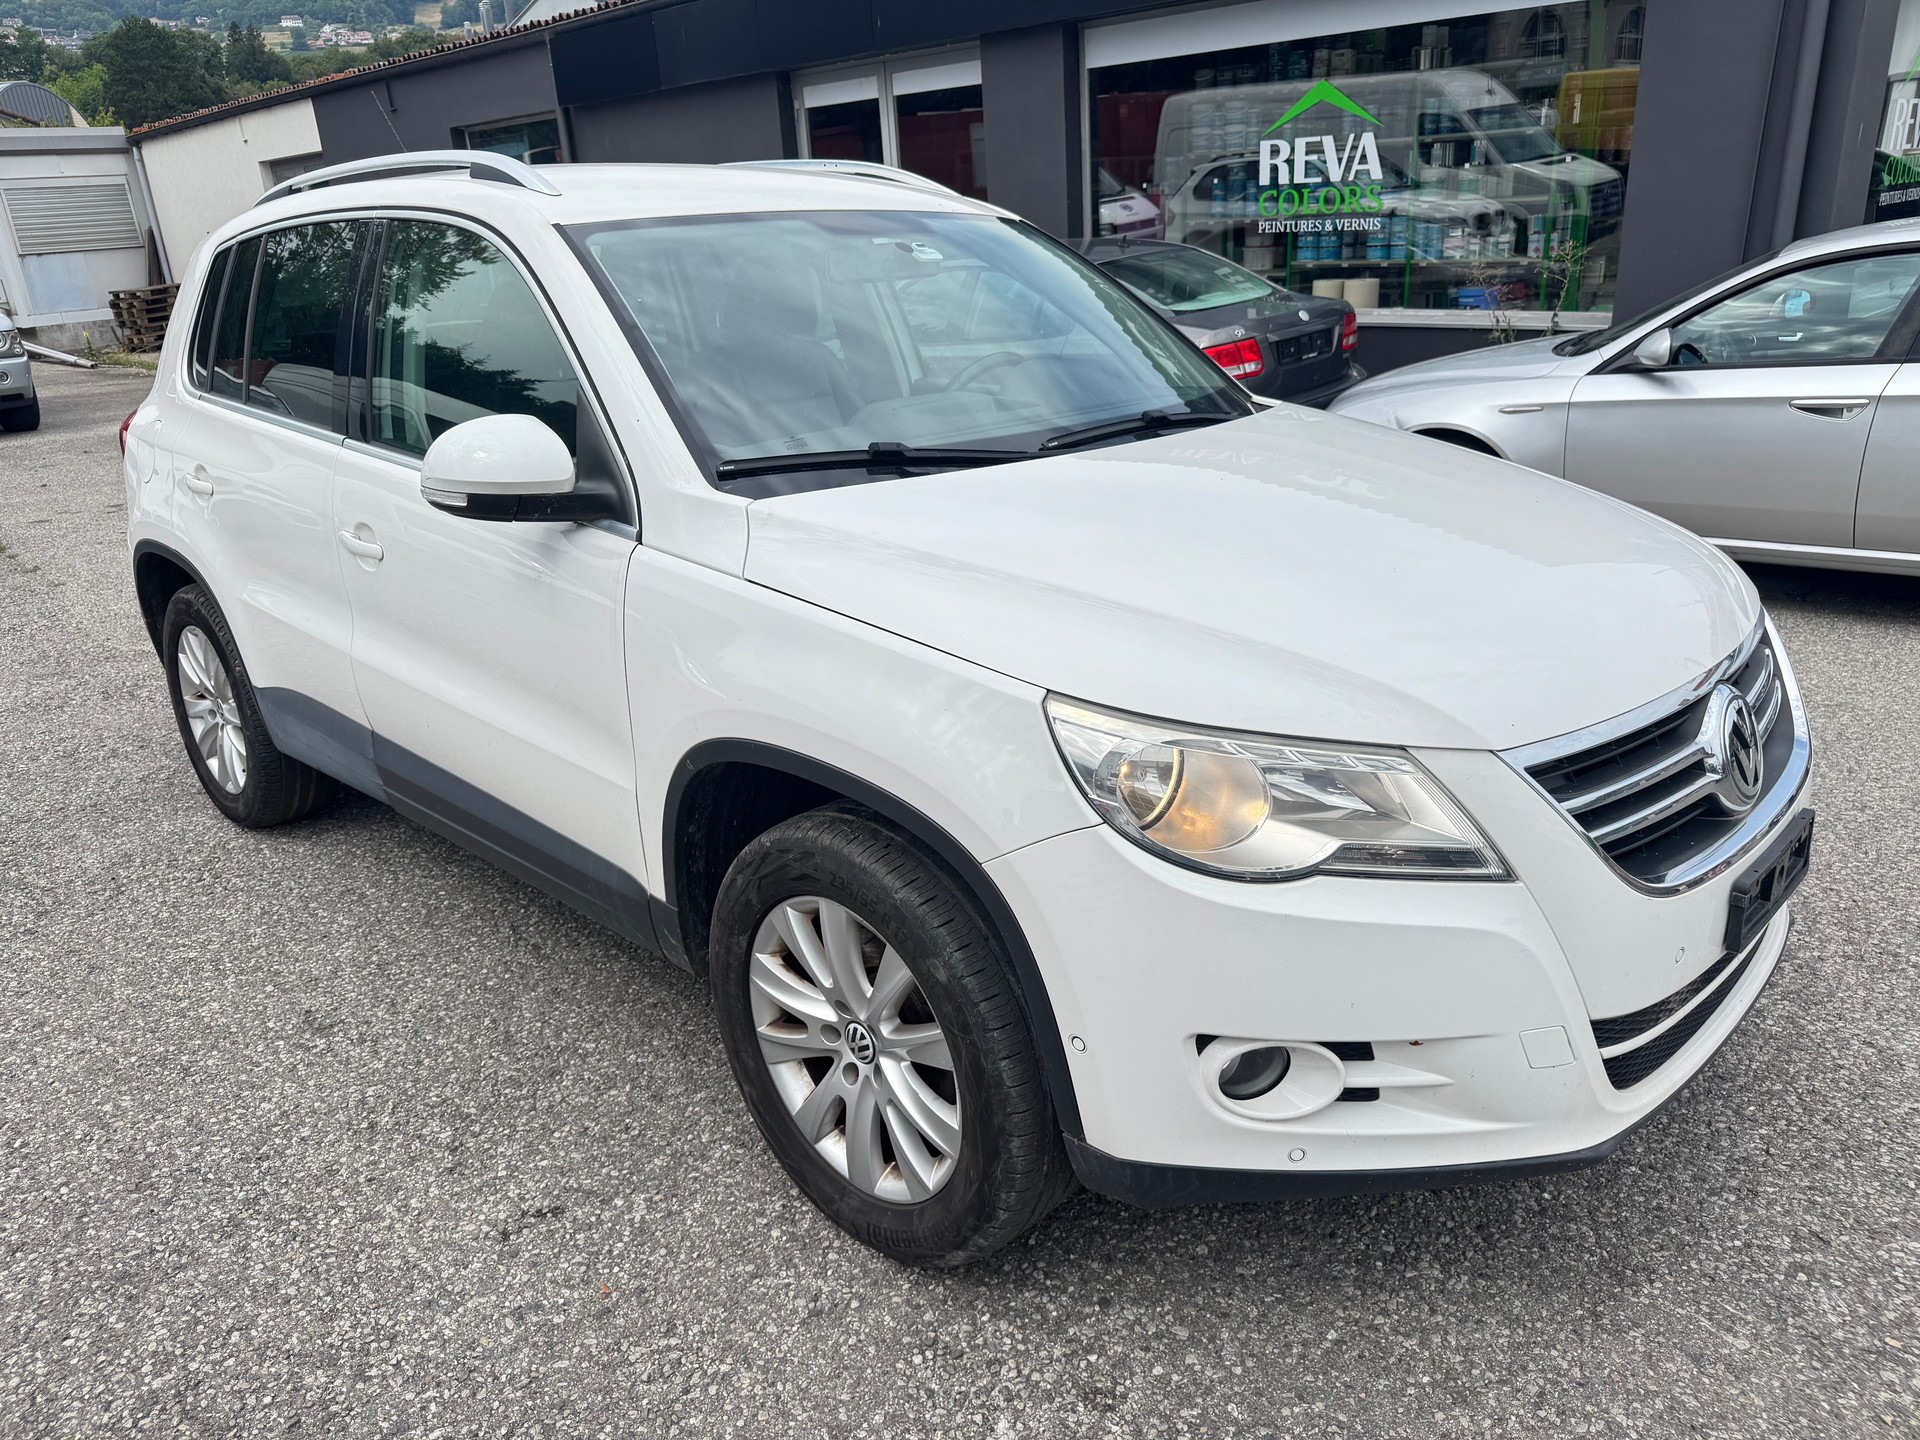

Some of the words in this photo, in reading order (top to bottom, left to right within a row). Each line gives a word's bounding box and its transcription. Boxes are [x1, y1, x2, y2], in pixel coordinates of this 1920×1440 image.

[1258, 131, 1384, 186] REVA
[1884, 154, 1920, 187] COLOR
[1258, 184, 1383, 217] COLORS
[1258, 219, 1322, 234] PEINTURES
[1324, 219, 1334, 231] &
[1335, 217, 1381, 232] VERNIS
